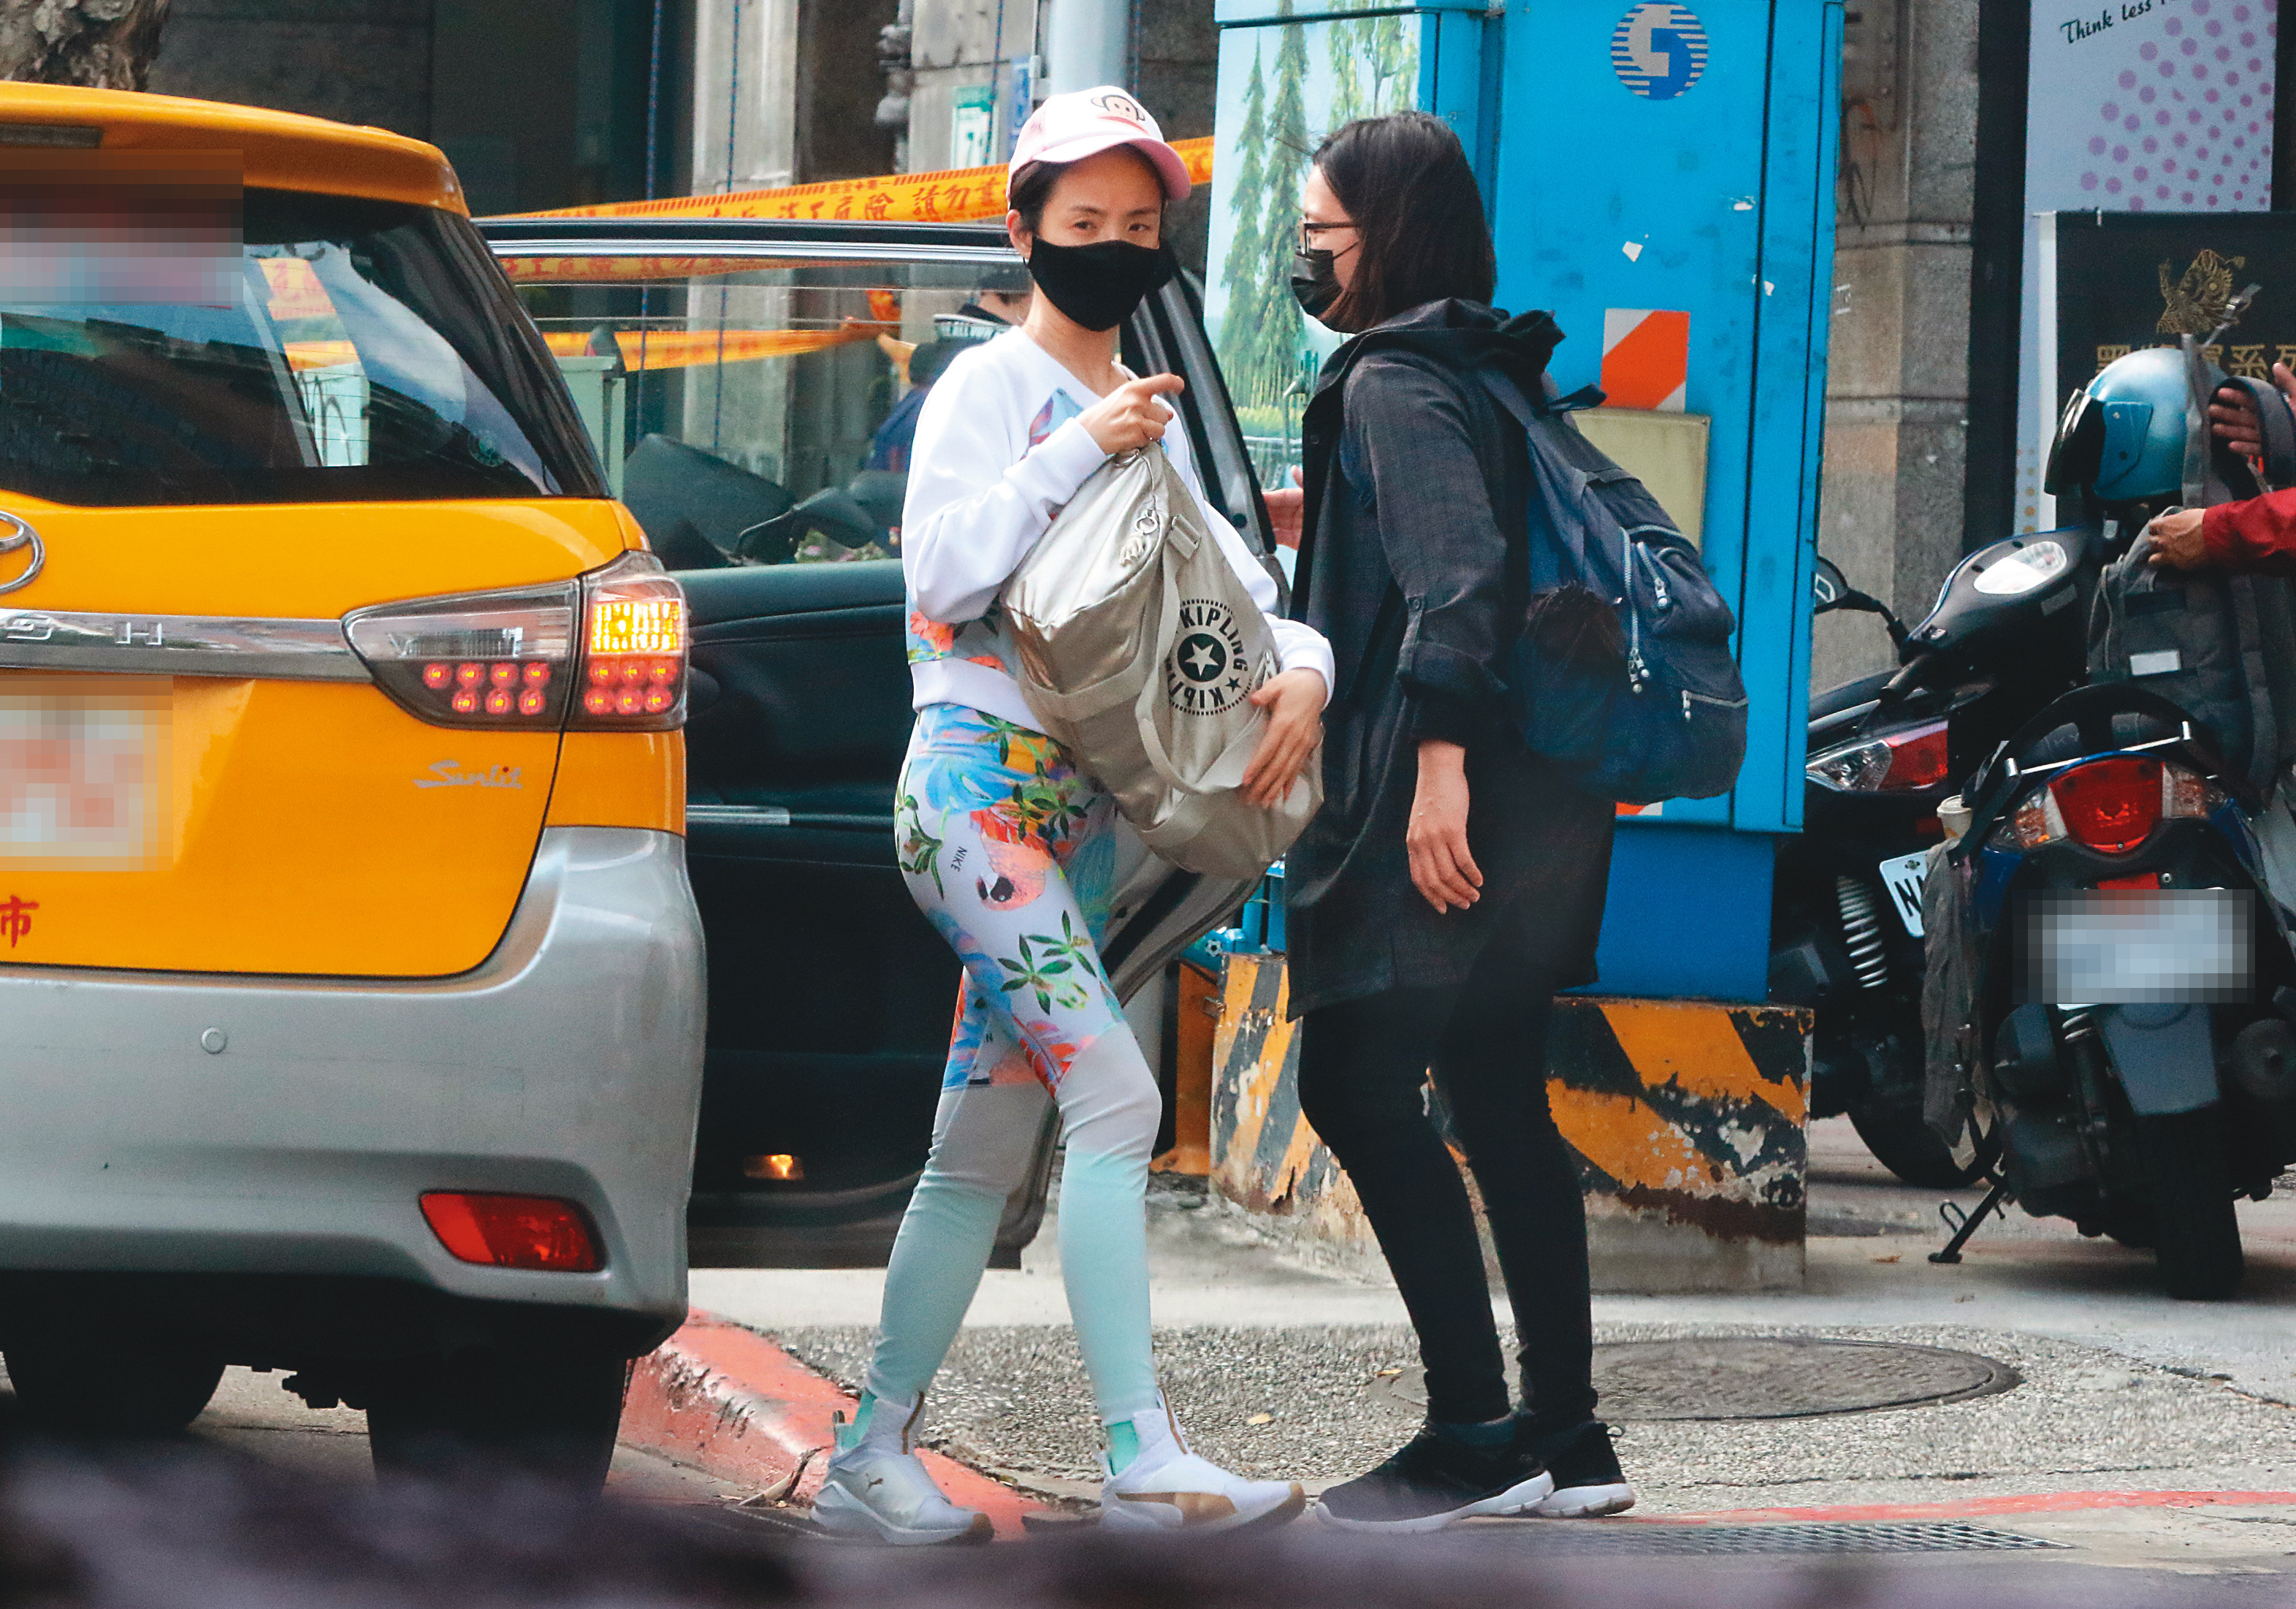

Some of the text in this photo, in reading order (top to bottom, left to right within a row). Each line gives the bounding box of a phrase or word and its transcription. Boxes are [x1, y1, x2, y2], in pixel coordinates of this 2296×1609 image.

[2060, 0, 2152, 44] Think less
[1180, 606, 1248, 672] KIPLING
[413, 758, 523, 790] Sunlit
[950, 846, 967, 872] NIKE
[1893, 875, 1923, 917] N
[0, 894, 39, 948] 市
